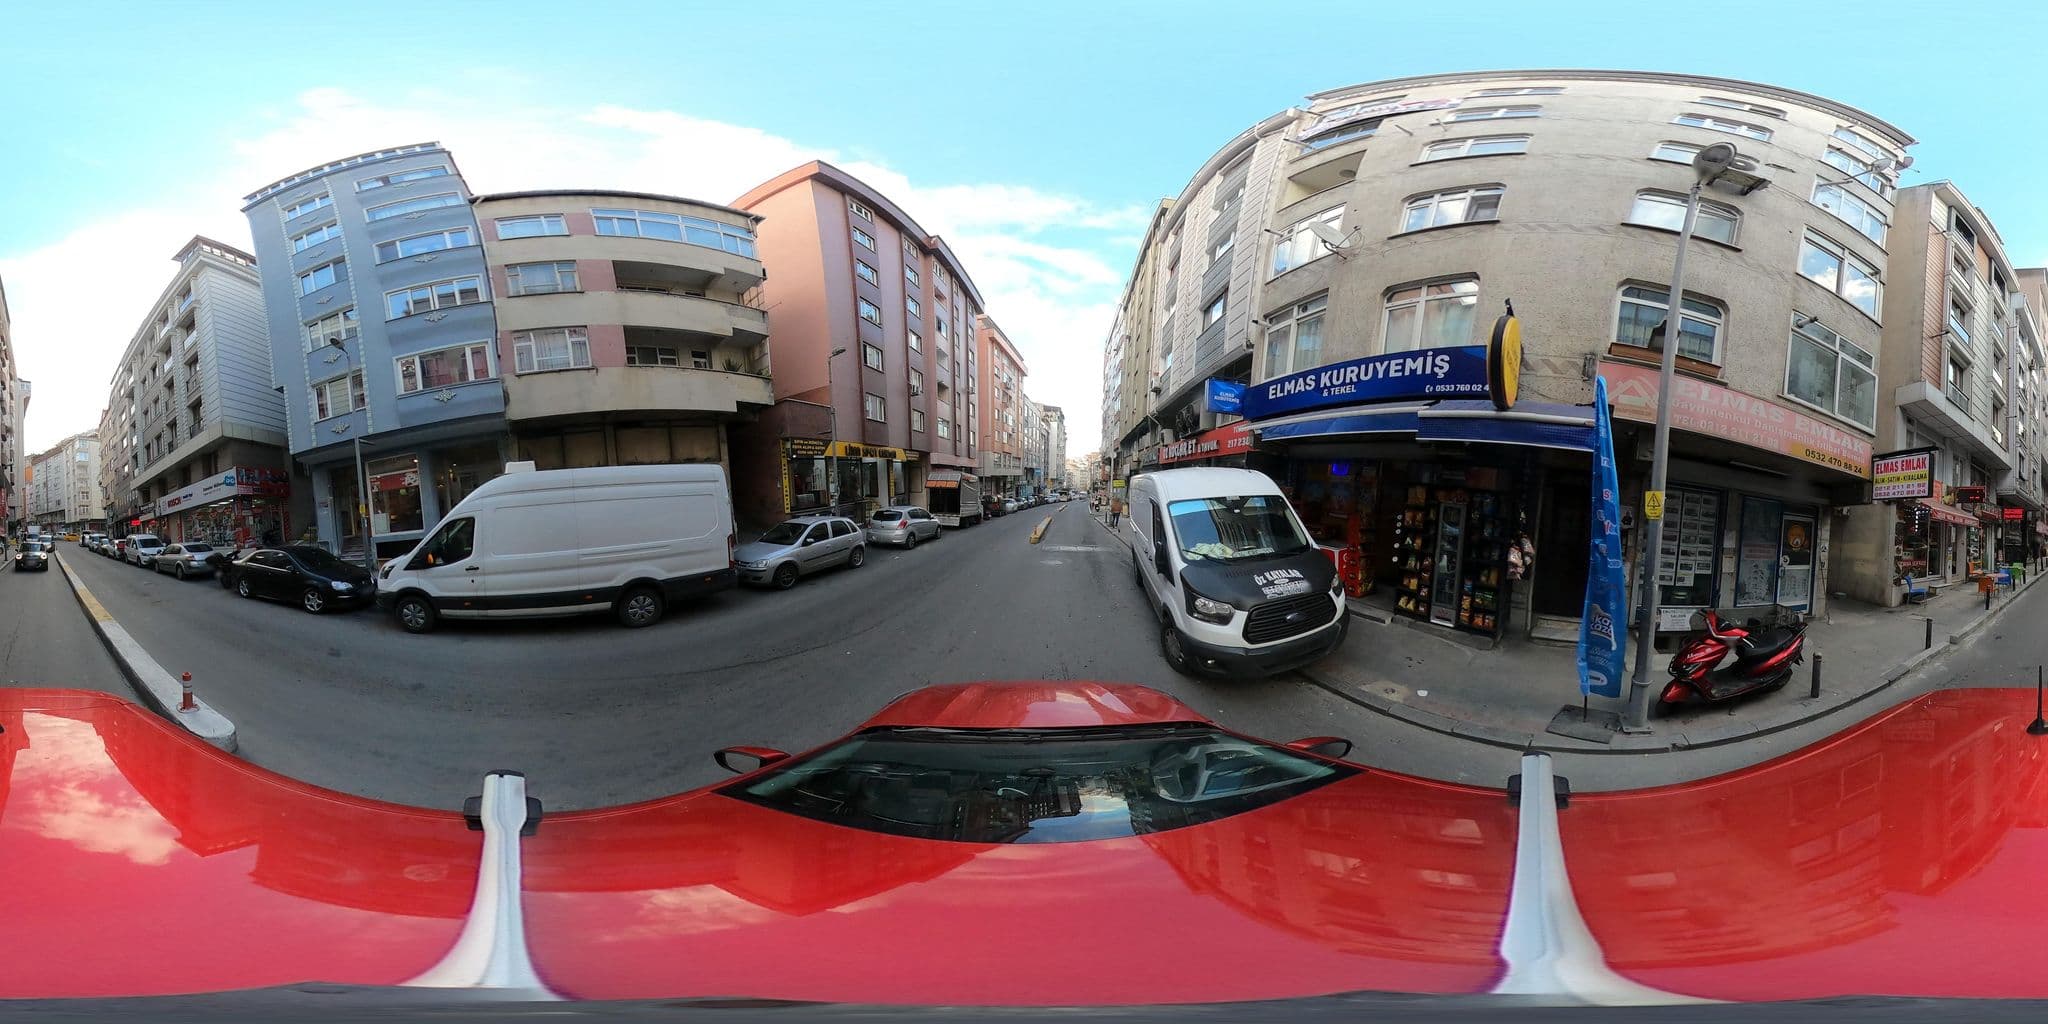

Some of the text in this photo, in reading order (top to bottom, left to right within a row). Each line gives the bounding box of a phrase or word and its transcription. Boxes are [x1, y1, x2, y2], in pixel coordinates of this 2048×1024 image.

[1269, 351, 1450, 400] ELMAS KURUYEMİŞ
[1322, 385, 1357, 397] & TEKEL
[1435, 384, 1454, 392] 0533
[1472, 384, 1482, 392] 02
[1677, 381, 1785, 422] ELMAS
[1795, 415, 1864, 453] EMLAK
[1805, 448, 1863, 474] 0532 470 88 24
[1876, 457, 1927, 475] ELMAS EMLAK
